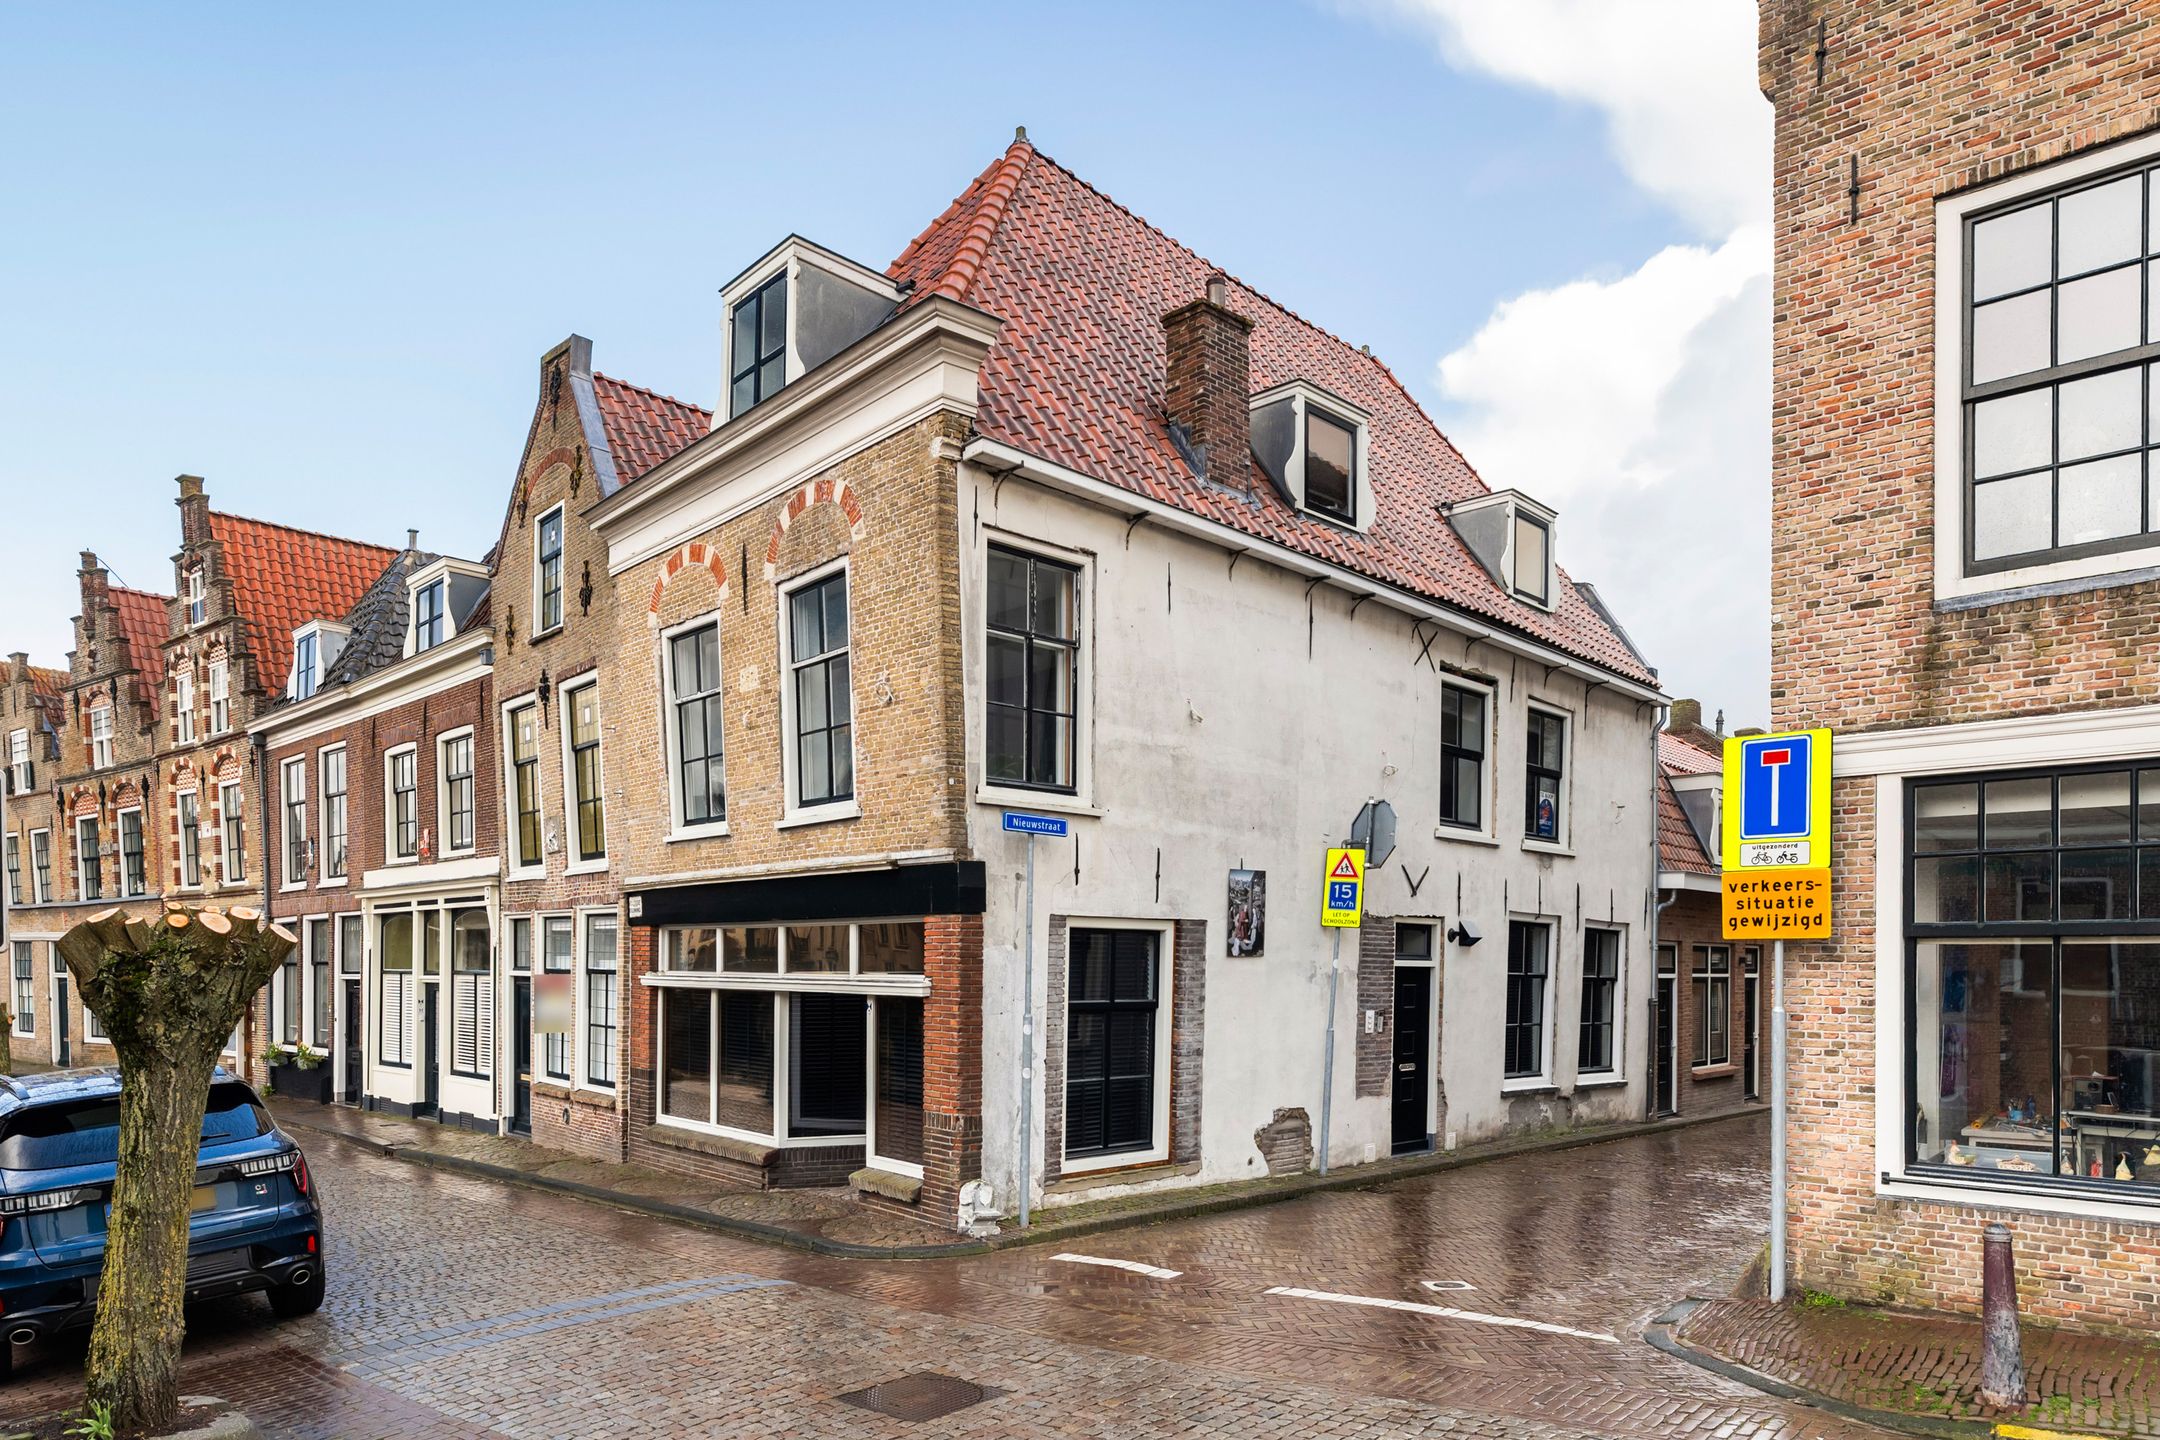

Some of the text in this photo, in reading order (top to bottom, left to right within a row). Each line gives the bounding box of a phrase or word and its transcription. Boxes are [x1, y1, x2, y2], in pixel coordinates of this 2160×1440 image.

[1012, 817, 1061, 832] Nieuwstraat
[1751, 843, 1799, 851] uitgezonderd
[1334, 884, 1352, 899] 15
[1729, 880, 1823, 893] verkeers-
[1330, 900, 1354, 908] km/h
[1736, 896, 1814, 910] situatie
[1729, 913, 1823, 931] gewijzigd
